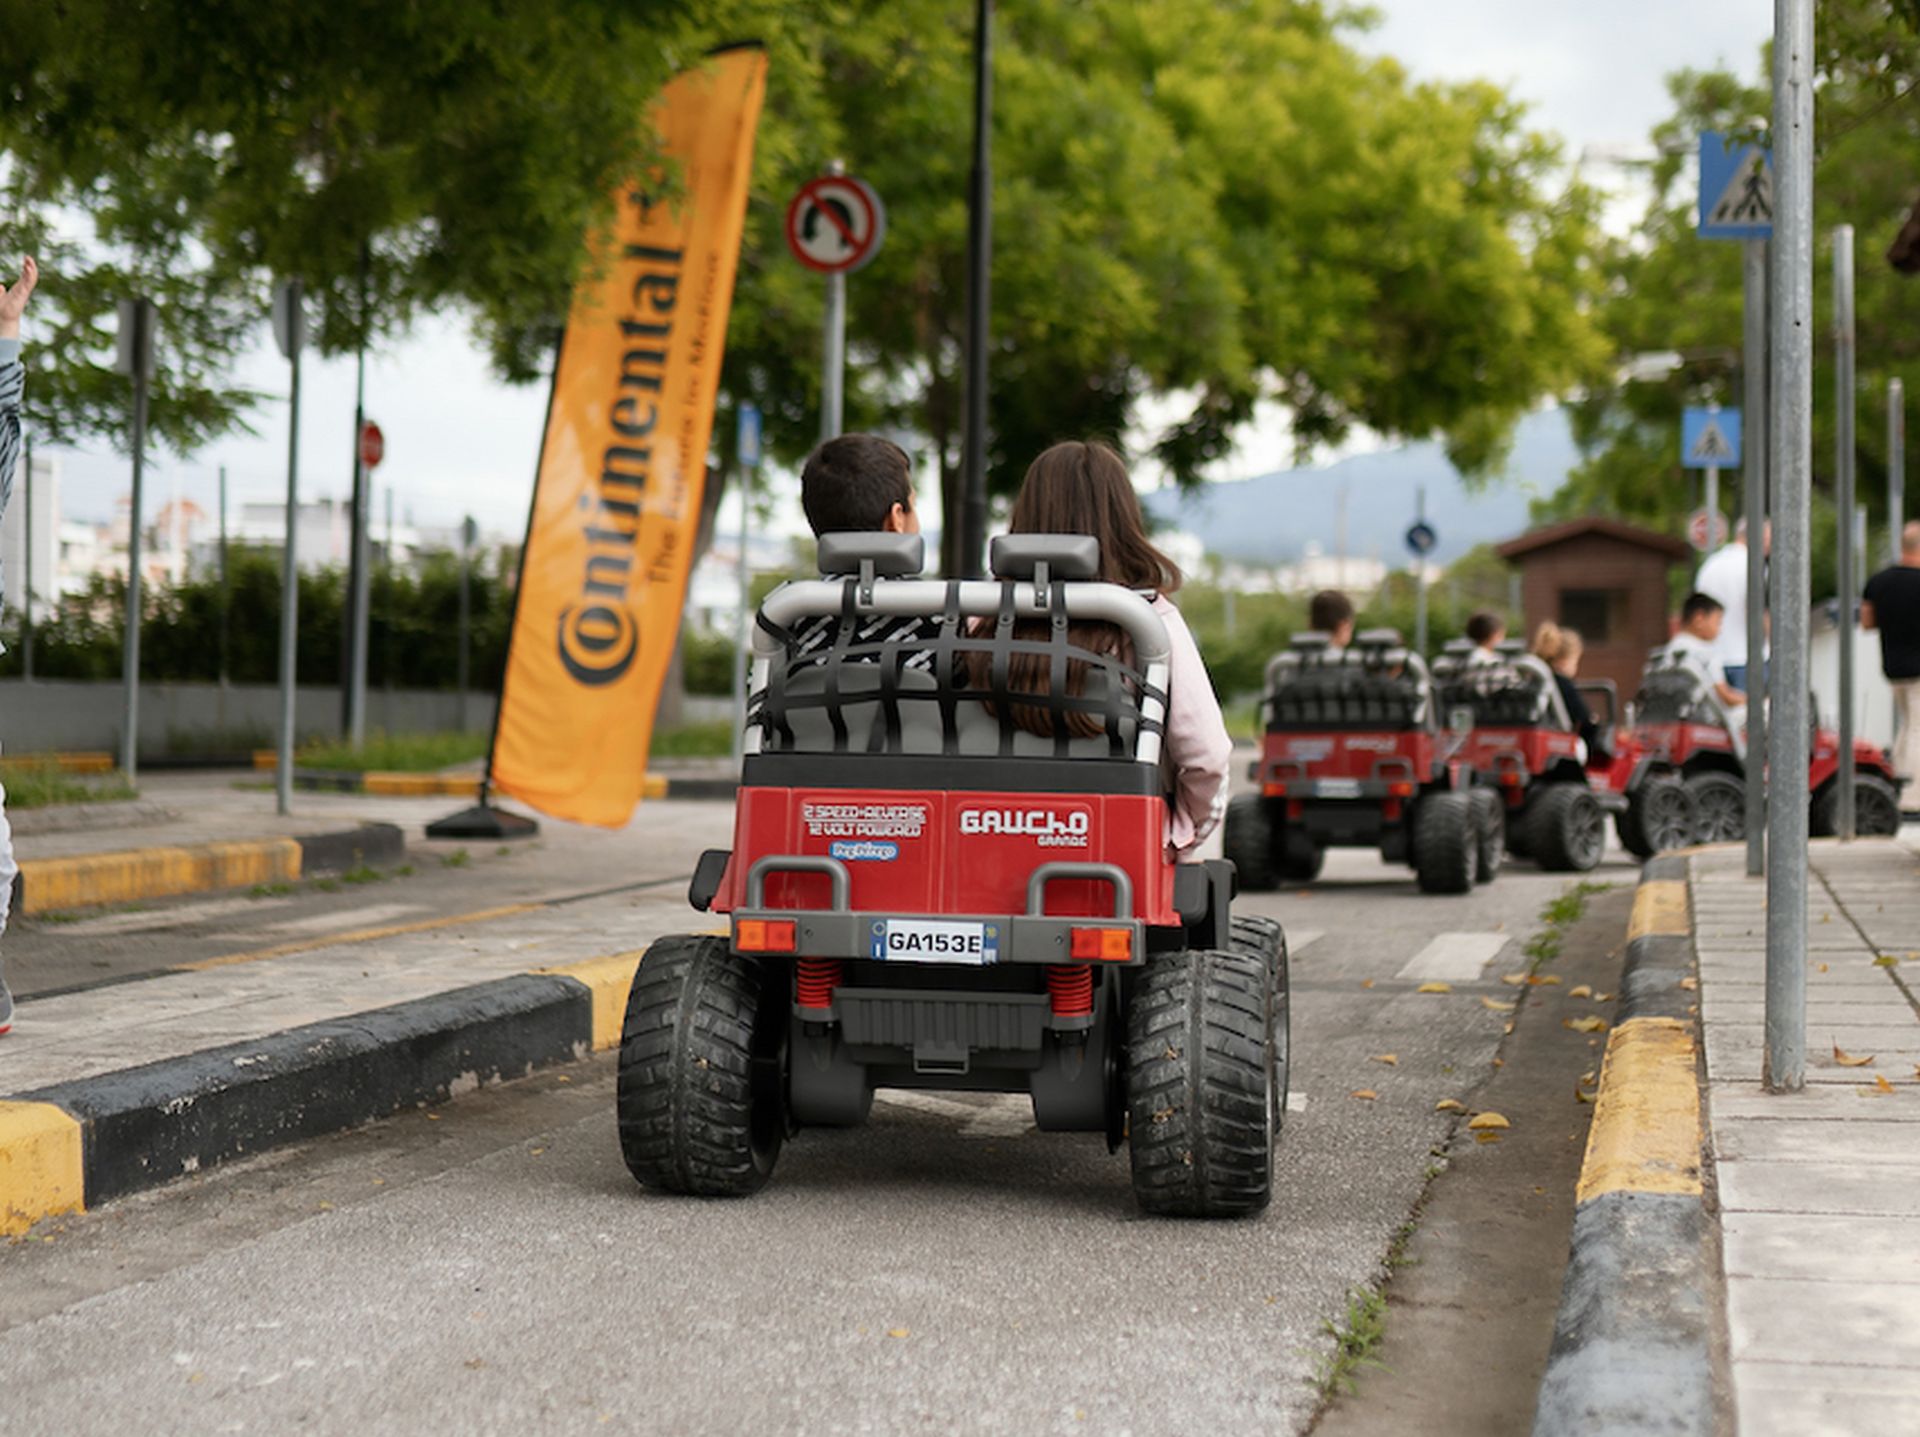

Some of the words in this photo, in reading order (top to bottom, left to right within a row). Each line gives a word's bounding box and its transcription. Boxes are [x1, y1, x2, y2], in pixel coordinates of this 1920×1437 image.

[557, 244, 685, 687] Continental
[648, 530, 678, 583] The
[823, 823, 853, 836] VOLT
[856, 824, 921, 837] POWERED
[1037, 835, 1087, 847] GRANDE
[888, 932, 981, 954] GA153E
